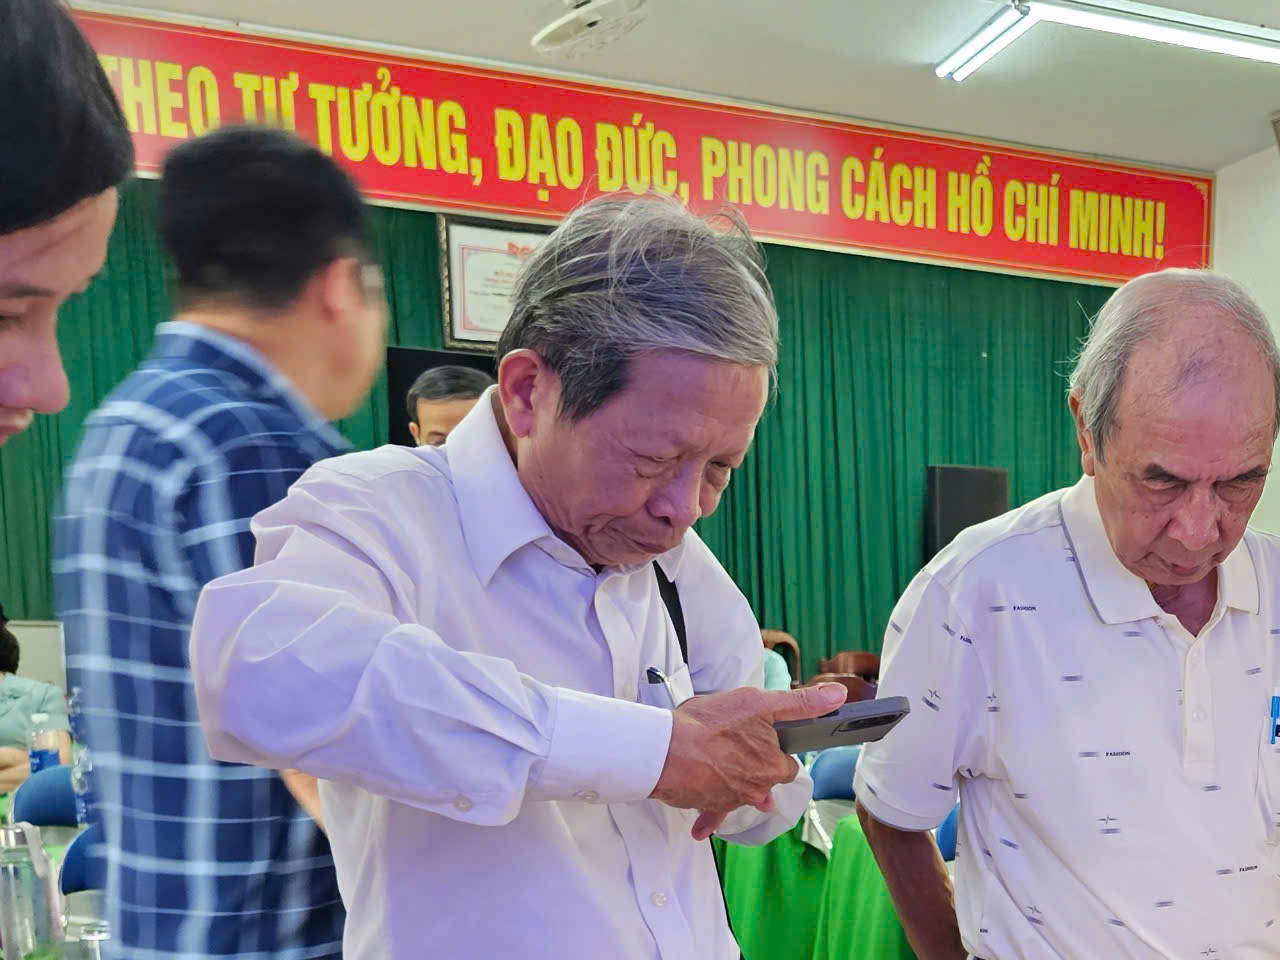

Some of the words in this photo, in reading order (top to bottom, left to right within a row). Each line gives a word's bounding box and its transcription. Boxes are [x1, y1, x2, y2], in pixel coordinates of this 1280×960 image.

[308, 67, 481, 186] TƯỞNG,
[494, 108, 584, 201] ĐẠO
[595, 113, 690, 206] ĐỨC,
[701, 137, 830, 215] PHONG
[841, 146, 937, 230] CÁCH
[947, 155, 993, 237] HỒ
[1003, 173, 1060, 246] CHÍ
[1068, 188, 1166, 260] MINH!
